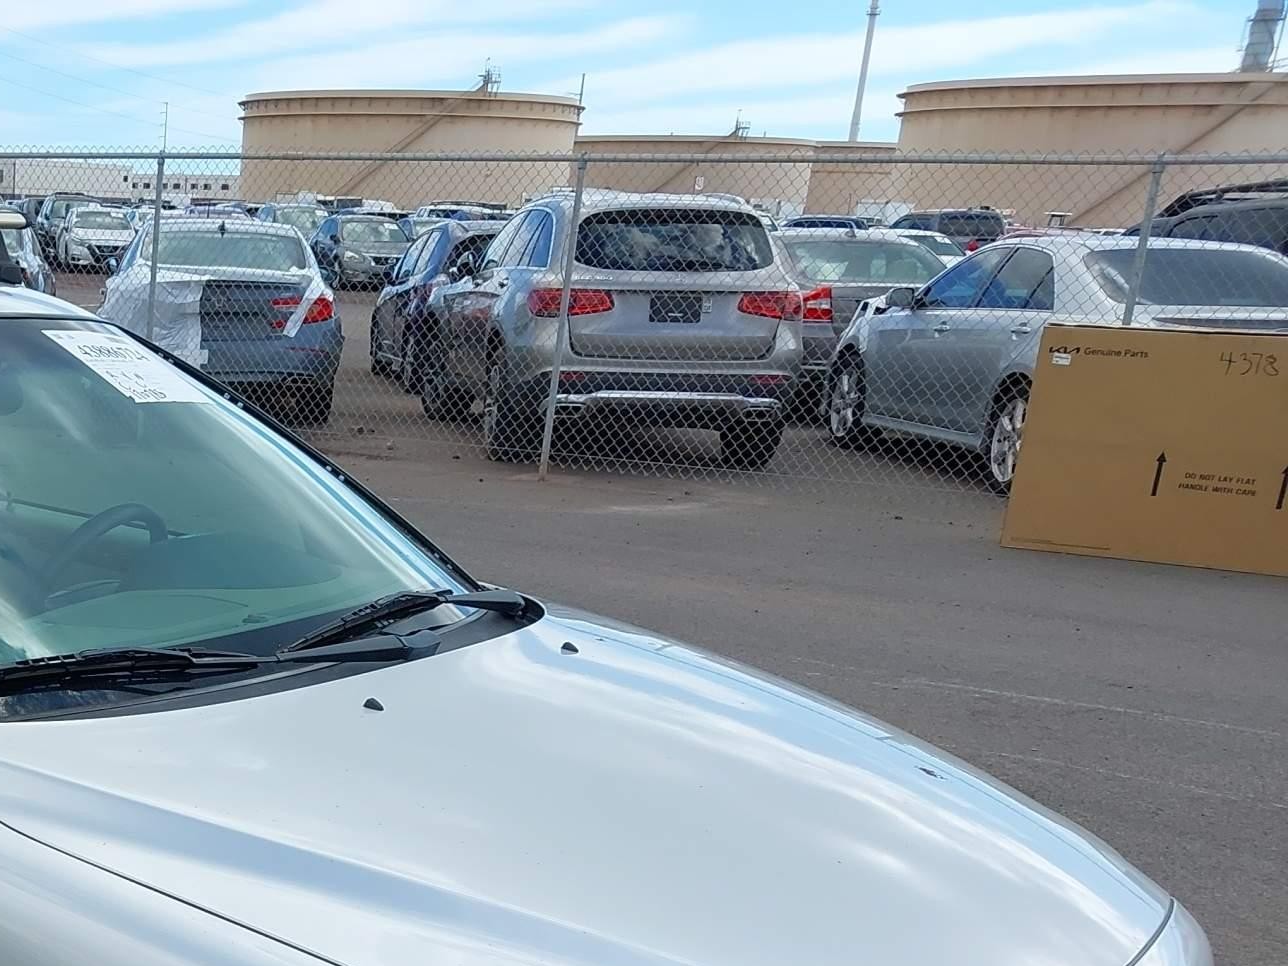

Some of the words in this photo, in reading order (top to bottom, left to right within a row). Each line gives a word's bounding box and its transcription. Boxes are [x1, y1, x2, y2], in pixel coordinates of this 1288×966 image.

[1083, 347, 1122, 357] Genuine
[1124, 349, 1149, 359] Parts
[1219, 351, 1280, 377] 4378
[1184, 472, 1197, 480] DO
[1199, 473, 1215, 481] NOT
[1218, 475, 1234, 483] LAY
[1236, 478, 1257, 486] FLAT
[1178, 482, 1209, 492] HANDLE
[1212, 486, 1234, 494] WITH
[1235, 489, 1257, 497] CARE
